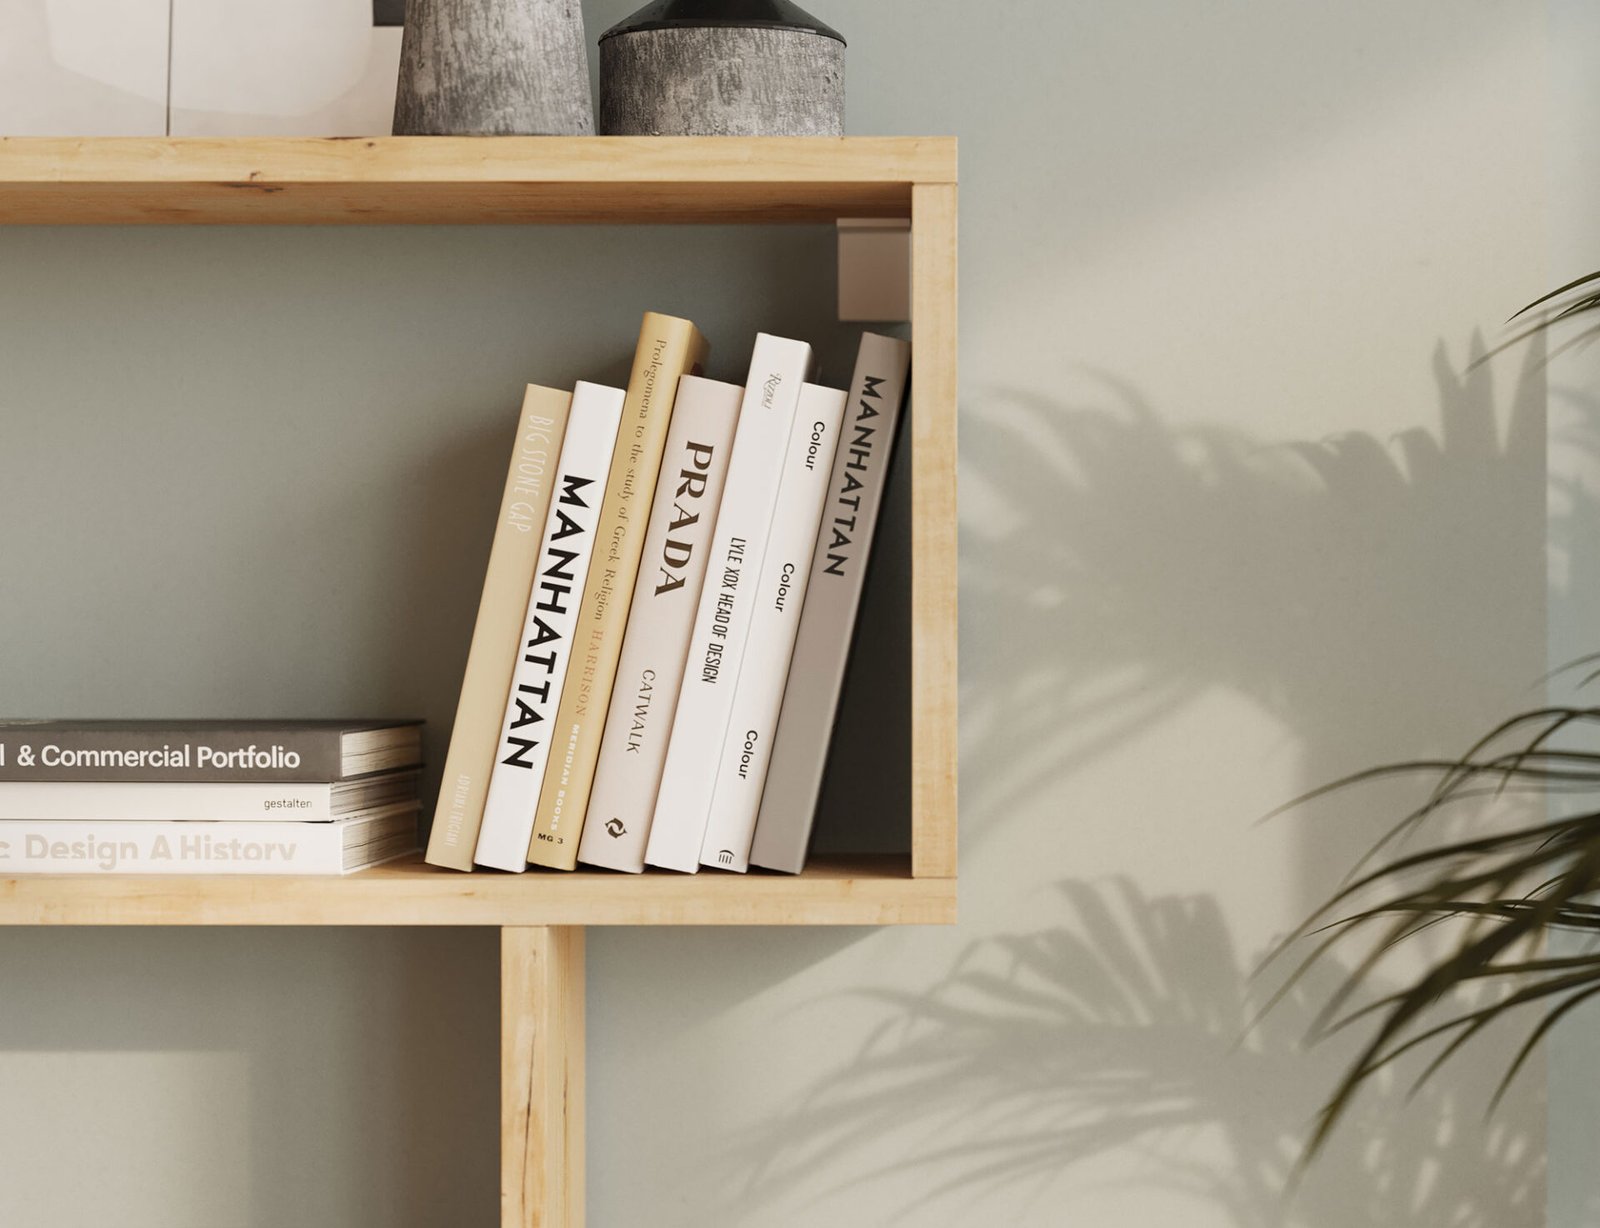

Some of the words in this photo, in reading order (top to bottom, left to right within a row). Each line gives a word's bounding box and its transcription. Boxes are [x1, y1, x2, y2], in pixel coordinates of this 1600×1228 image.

[639, 339, 667, 419] Prolegomena
[526, 414, 553, 443] BIG
[635, 425, 645, 438] to
[805, 421, 825, 470] Colour
[515, 446, 547, 497] STONE
[629, 444, 643, 463] the
[618, 468, 635, 501] study
[824, 376, 886, 576] MANHATTAN
[508, 502, 535, 533] GAP
[618, 506, 628, 521] of
[654, 441, 714, 597] PRADA
[607, 526, 625, 562] Greek
[728, 537, 746, 563] LYLE
[594, 569, 616, 620] Religion
[721, 566, 739, 591] XOX
[775, 563, 794, 612] Colour
[501, 475, 596, 769] MANHATTAN
[714, 593, 734, 626] HEAD
[712, 625, 728, 640] OF
[576, 629, 602, 716] HARRISON
[702, 643, 723, 684] DESIGN
[626, 669, 655, 753] CATWALK
[17, 745, 35, 767] &
[41, 744, 190, 768] Commercial
[198, 745, 300, 769] Portfolio
[560, 724, 580, 786] MERIDIAN
[738, 730, 757, 779] Colour
[264, 798, 312, 811] gestalten
[550, 791, 566, 831] BOOKS
[25, 834, 138, 870] Design
[150, 834, 173, 860] A
[538, 833, 554, 843] MG
[557, 837, 564, 845] 3
